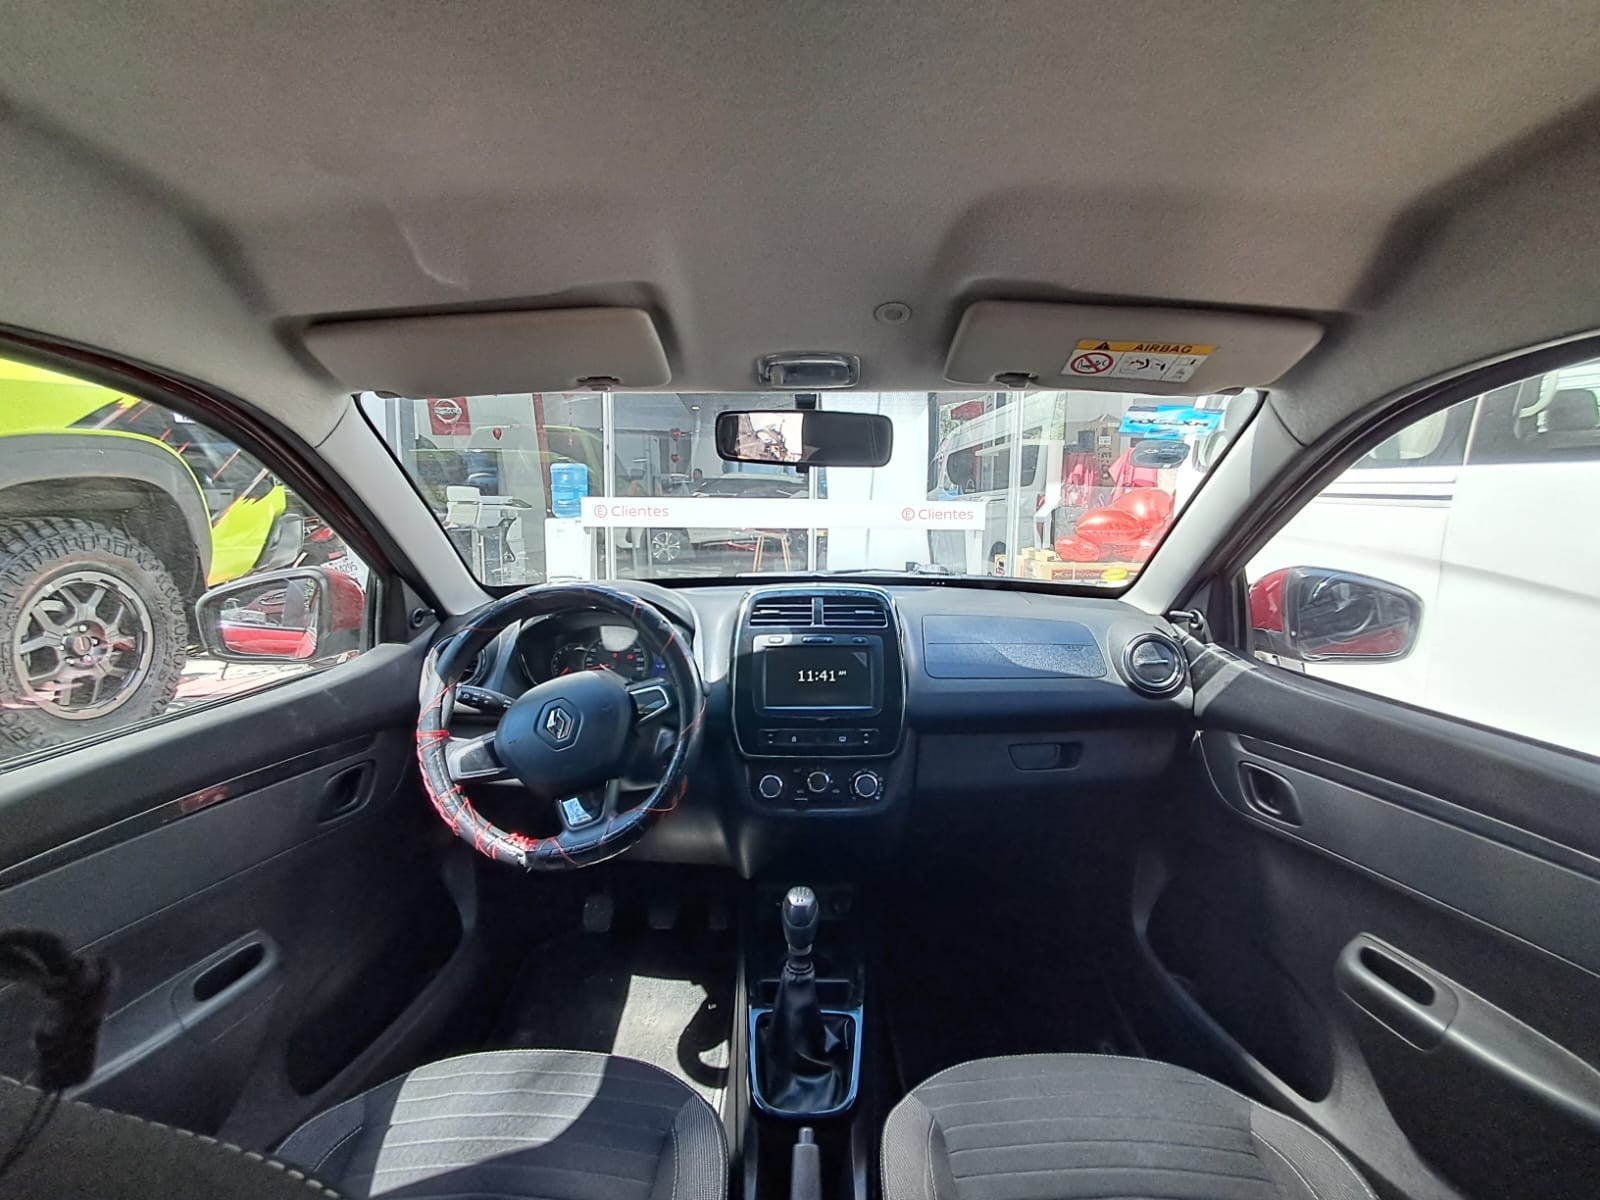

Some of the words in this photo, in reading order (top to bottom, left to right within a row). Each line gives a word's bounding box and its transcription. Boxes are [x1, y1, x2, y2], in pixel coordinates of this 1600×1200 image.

[1134, 343, 1192, 353] AIRBAG
[611, 505, 669, 517] Clientes
[918, 508, 974, 520] Clientes
[798, 669, 836, 682] 11:41
